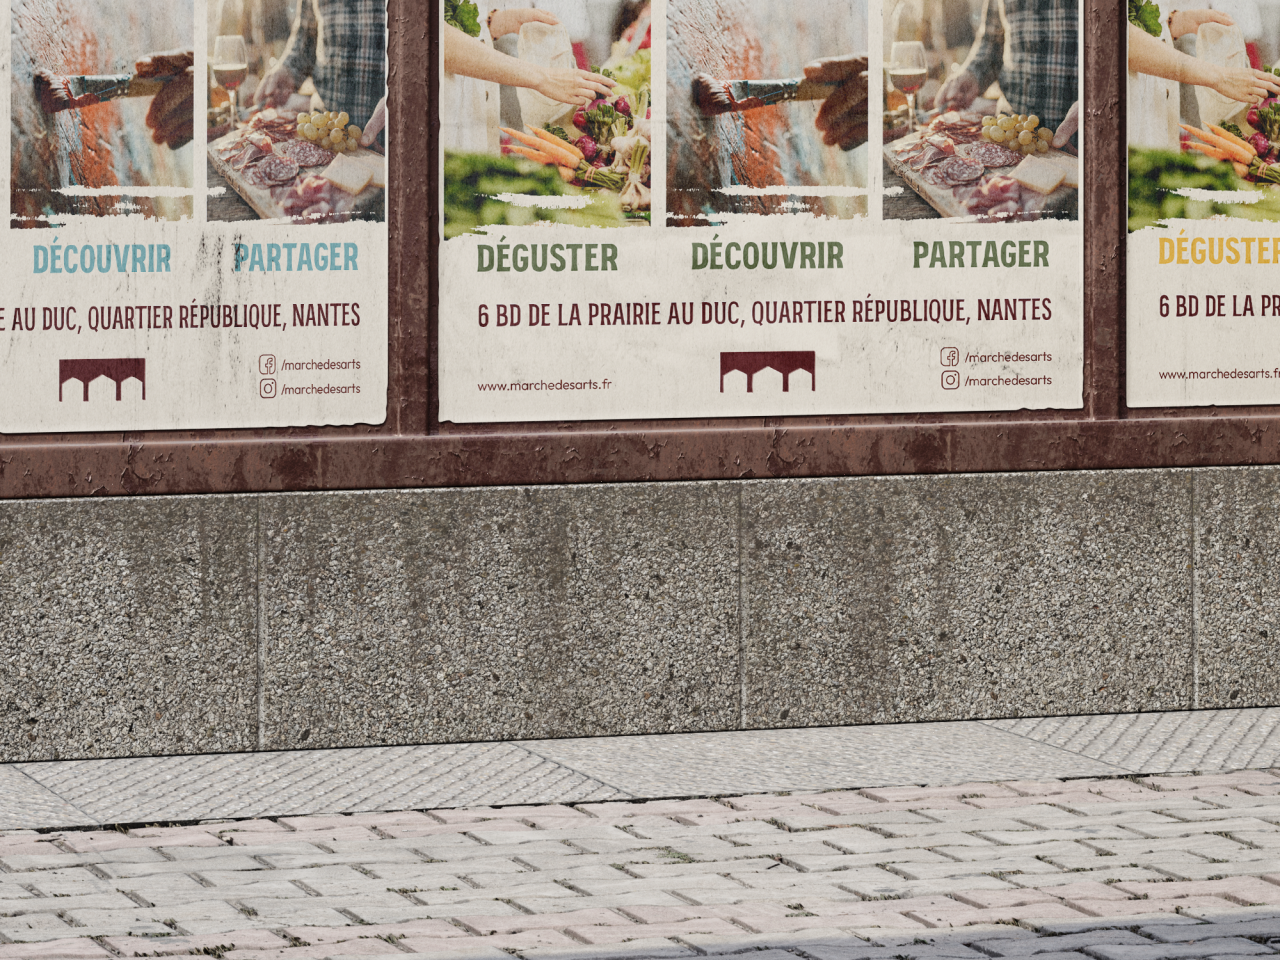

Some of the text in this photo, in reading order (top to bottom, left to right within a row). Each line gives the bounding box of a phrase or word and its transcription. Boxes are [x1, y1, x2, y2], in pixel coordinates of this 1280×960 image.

[33, 237, 171, 274] DÉCOUVRIR
[234, 242, 358, 272] PARTAGER
[477, 236, 618, 272] DÉGUSTER
[692, 234, 844, 270] DÉCOUVRIR
[913, 240, 1049, 268] PARTAGER
[12, 306, 36, 331] AU
[42, 305, 82, 334] DUC,
[88, 305, 173, 333] QUARTIER
[179, 299, 287, 331] RÉPUBLIQUE,
[292, 302, 360, 327] NANTES
[478, 294, 1052, 328] 6 BD DE LA PRAIRIE AU DUC, QUARTIER RÉPUBLIQUE, NANTES
[1159, 295, 1170, 317] 6
[1176, 295, 1199, 317] BD
[1206, 294, 1226, 317] DE
[1233, 294, 1255, 316] LA
[281, 359, 361, 372] /marchedesarts
[965, 350, 1052, 365] /marchedesarts
[281, 383, 361, 395] /marchedesarts
[477, 379, 612, 392] www.marchedesarts.fr
[965, 373, 1052, 387] /marchedesarts
